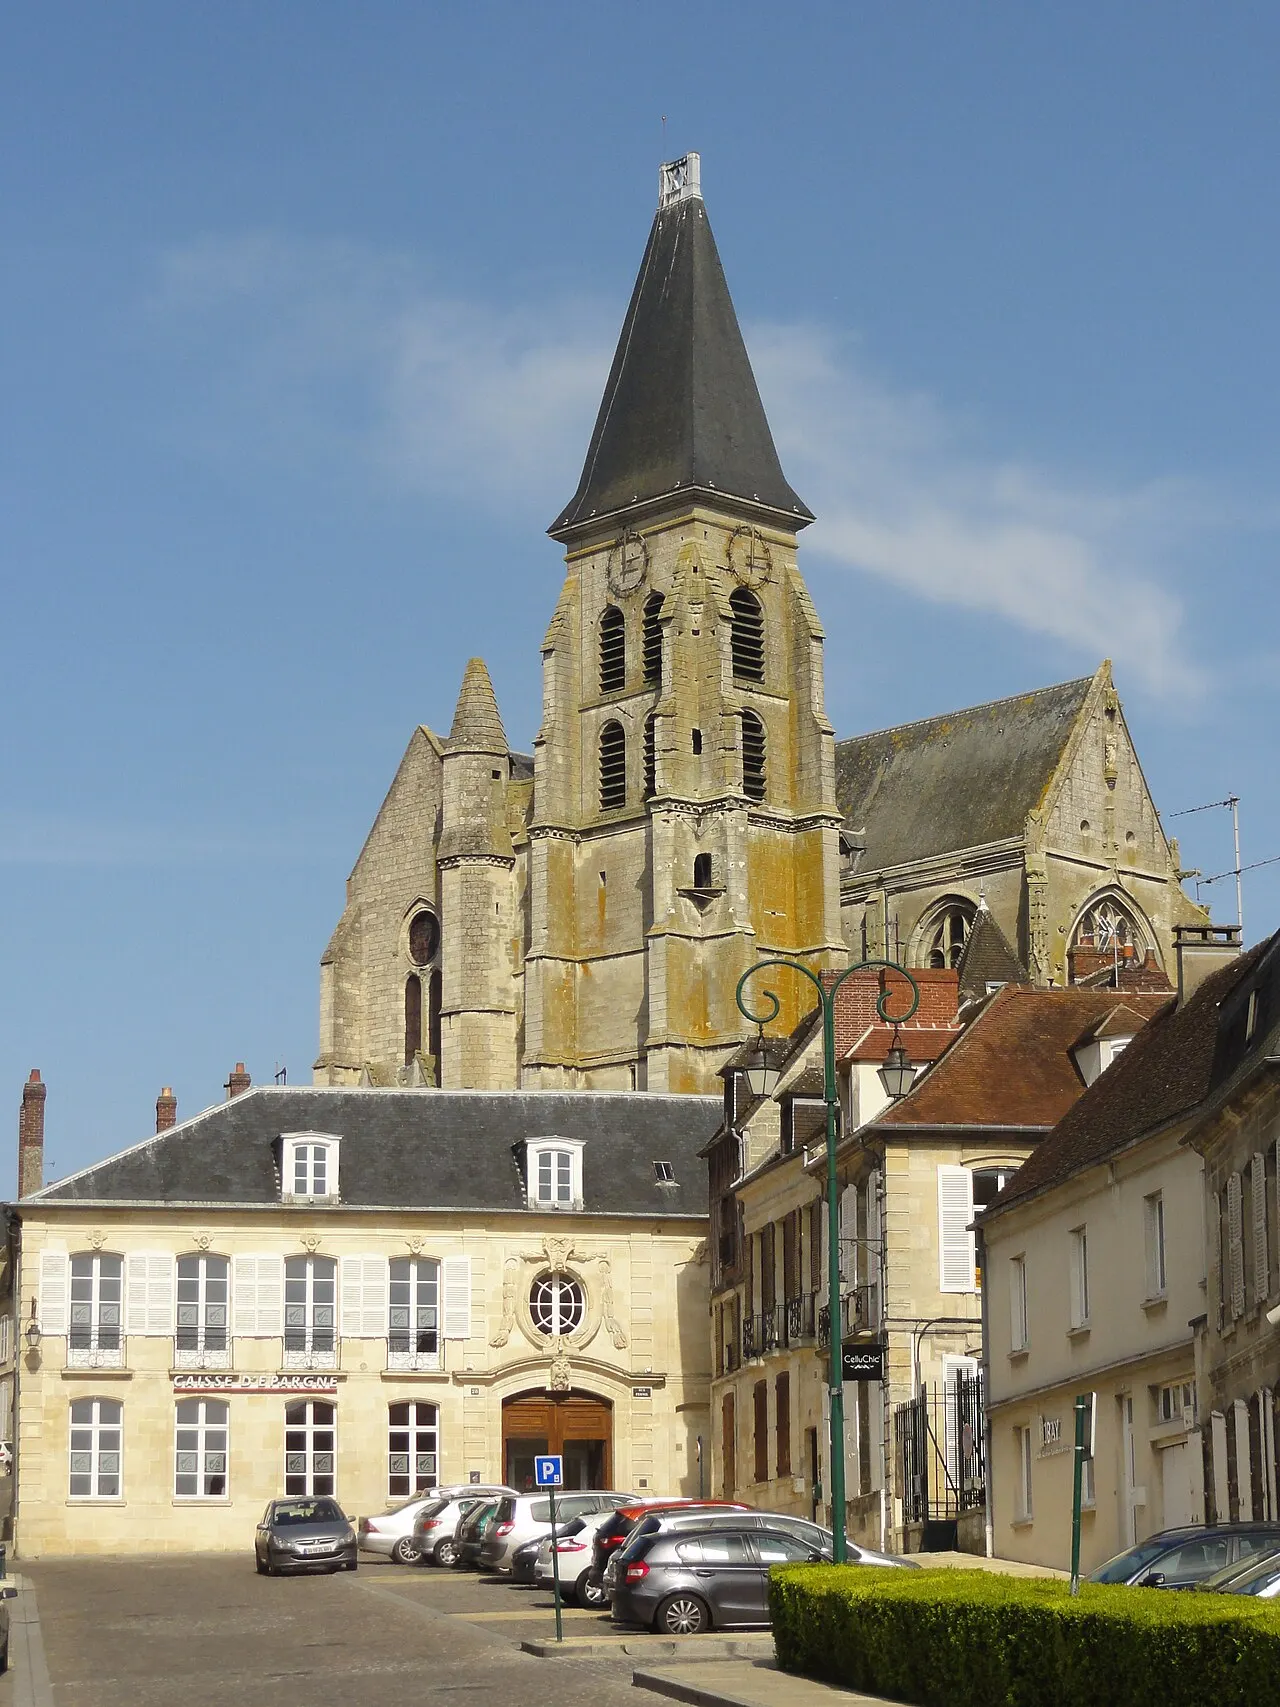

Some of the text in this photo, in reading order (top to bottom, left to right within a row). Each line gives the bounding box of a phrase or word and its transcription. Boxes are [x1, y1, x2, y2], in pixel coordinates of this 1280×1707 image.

[844, 1354, 880, 1364] CelluChic
[173, 1375, 233, 1388] CAISSE
[542, 1461, 555, 1480] P
